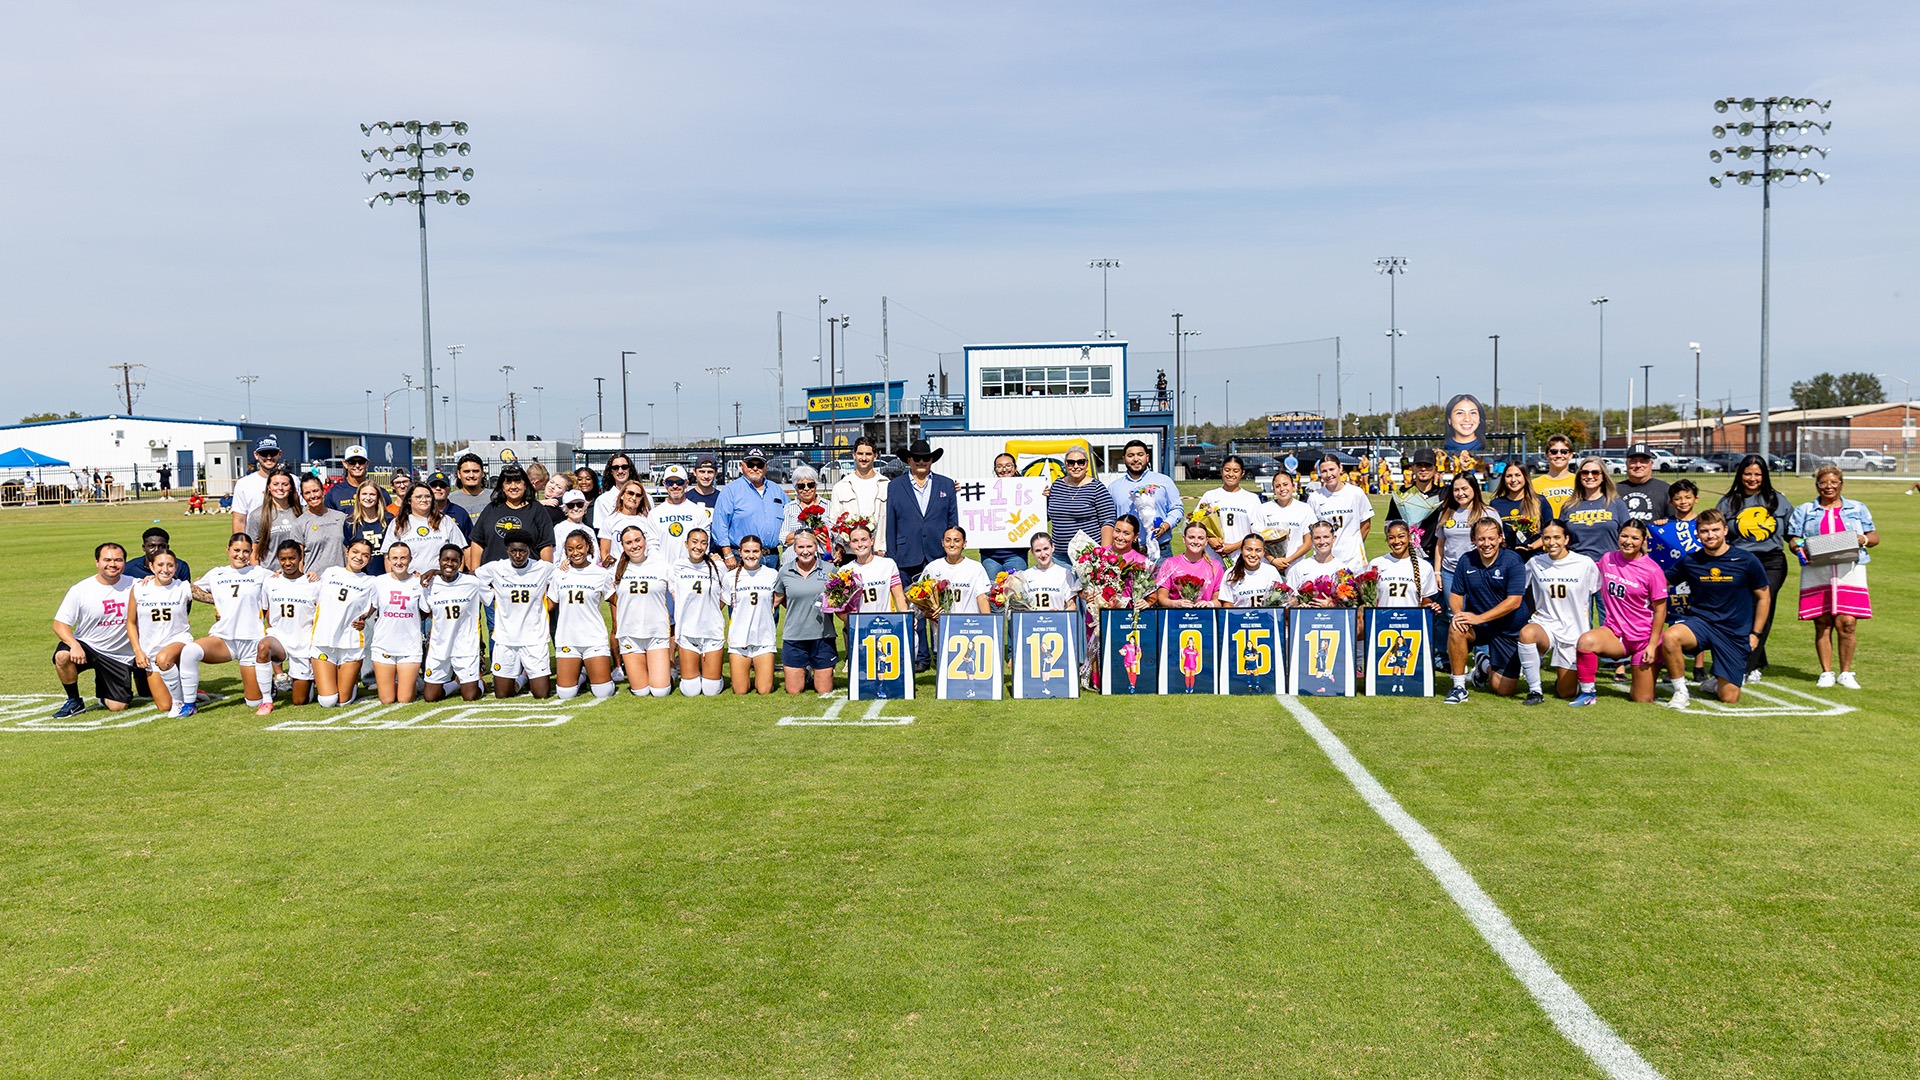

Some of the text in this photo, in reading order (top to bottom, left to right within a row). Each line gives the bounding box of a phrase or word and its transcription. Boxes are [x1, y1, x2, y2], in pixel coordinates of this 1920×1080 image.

[1015, 483, 1034, 506] is
[659, 514, 693, 523] LIONS
[963, 508, 1007, 531] THE
[1226, 513, 1235, 527] 8
[1569, 511, 1613, 523] SOCCER
[1007, 513, 1041, 543] QUEEN
[362, 530, 383, 549] ET
[346, 583, 363, 592] TEXAS
[629, 580, 648, 595] 23
[692, 580, 703, 595] 4
[1389, 582, 1408, 598] 27
[1618, 576, 1639, 589] TEXAS
[230, 584, 241, 598] 7
[338, 587, 348, 602] 9
[511, 590, 530, 604] 28
[568, 590, 584, 604] 14
[750, 591, 759, 606] 3
[862, 587, 879, 604] 19
[1549, 584, 1567, 599] 10
[102, 599, 125, 617] ET
[389, 591, 410, 610] ET
[1035, 593, 1050, 608] 12
[1250, 595, 1265, 608] 15
[151, 608, 172, 622] 25
[280, 603, 295, 618] 13
[384, 611, 414, 619] SOCCER
[444, 605, 461, 620] 18
[98, 619, 128, 627] SOCCE
[862, 634, 901, 681] 19
[947, 634, 995, 681] 20
[1026, 632, 1065, 679] 12
[1126, 629, 1141, 675] 1
[1179, 629, 1203, 676] 0
[1232, 629, 1272, 675] 15
[1305, 630, 1340, 676] 17
[1377, 629, 1422, 676] 27
